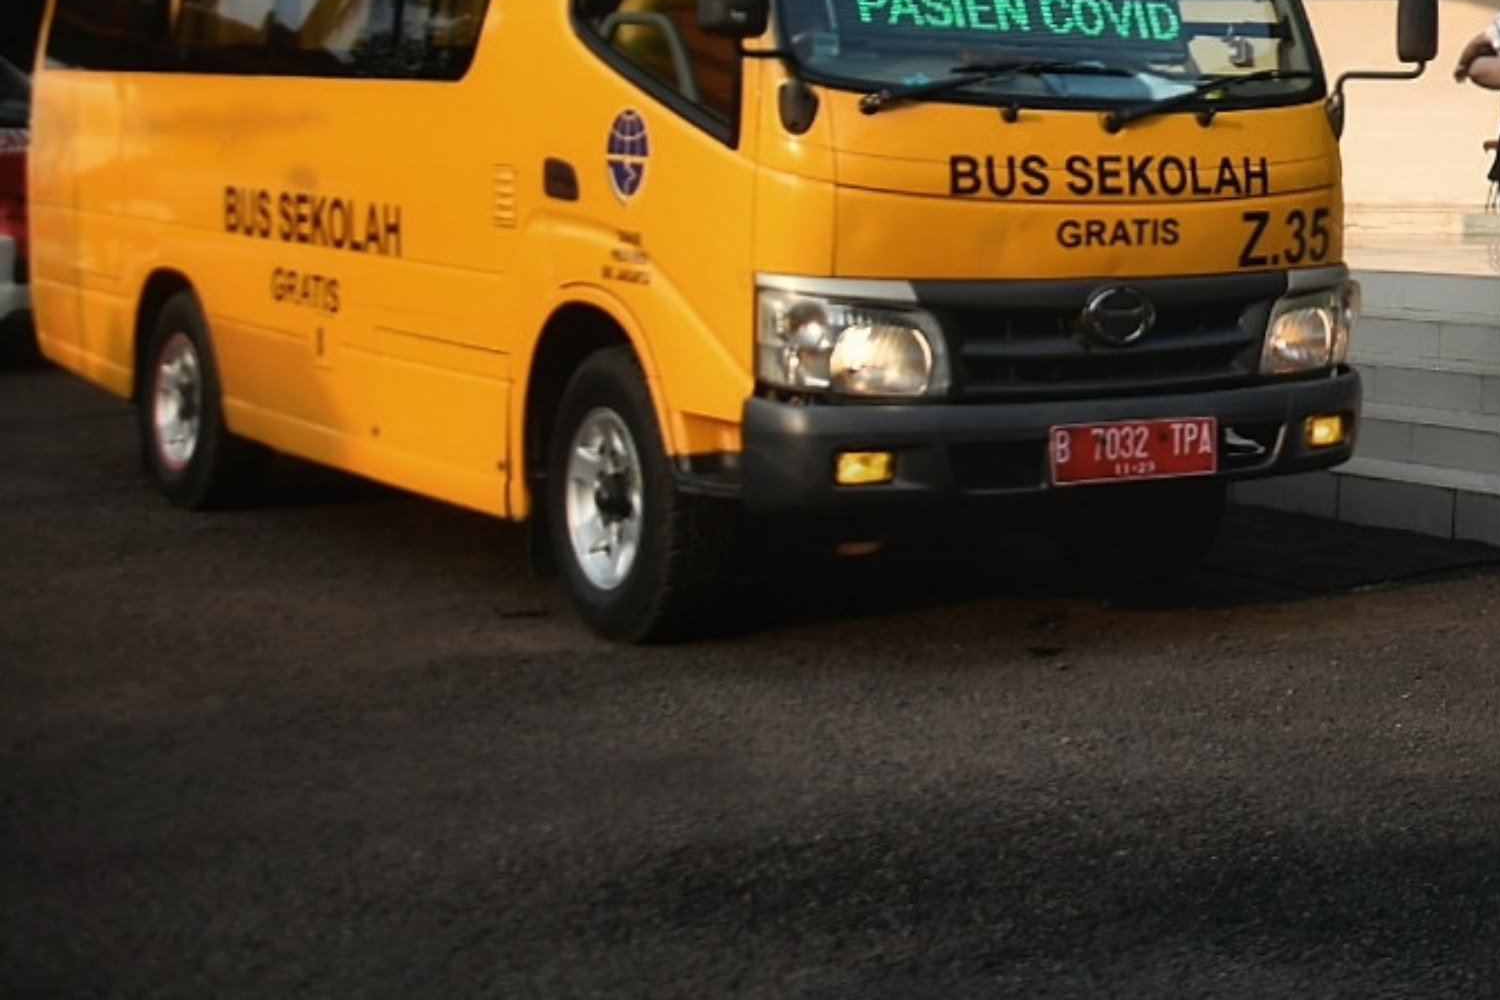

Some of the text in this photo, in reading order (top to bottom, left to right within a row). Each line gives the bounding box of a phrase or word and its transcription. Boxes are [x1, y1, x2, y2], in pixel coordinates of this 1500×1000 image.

[948, 155, 1269, 197] BUS SEKOLAH
[224, 186, 402, 257] BUS SEKOLAH
[1056, 218, 1180, 248] GRATIS
[1238, 208, 1330, 267] Z.35
[270, 267, 341, 313] GRATIS
[1055, 422, 1213, 463] B 7032 TPA
